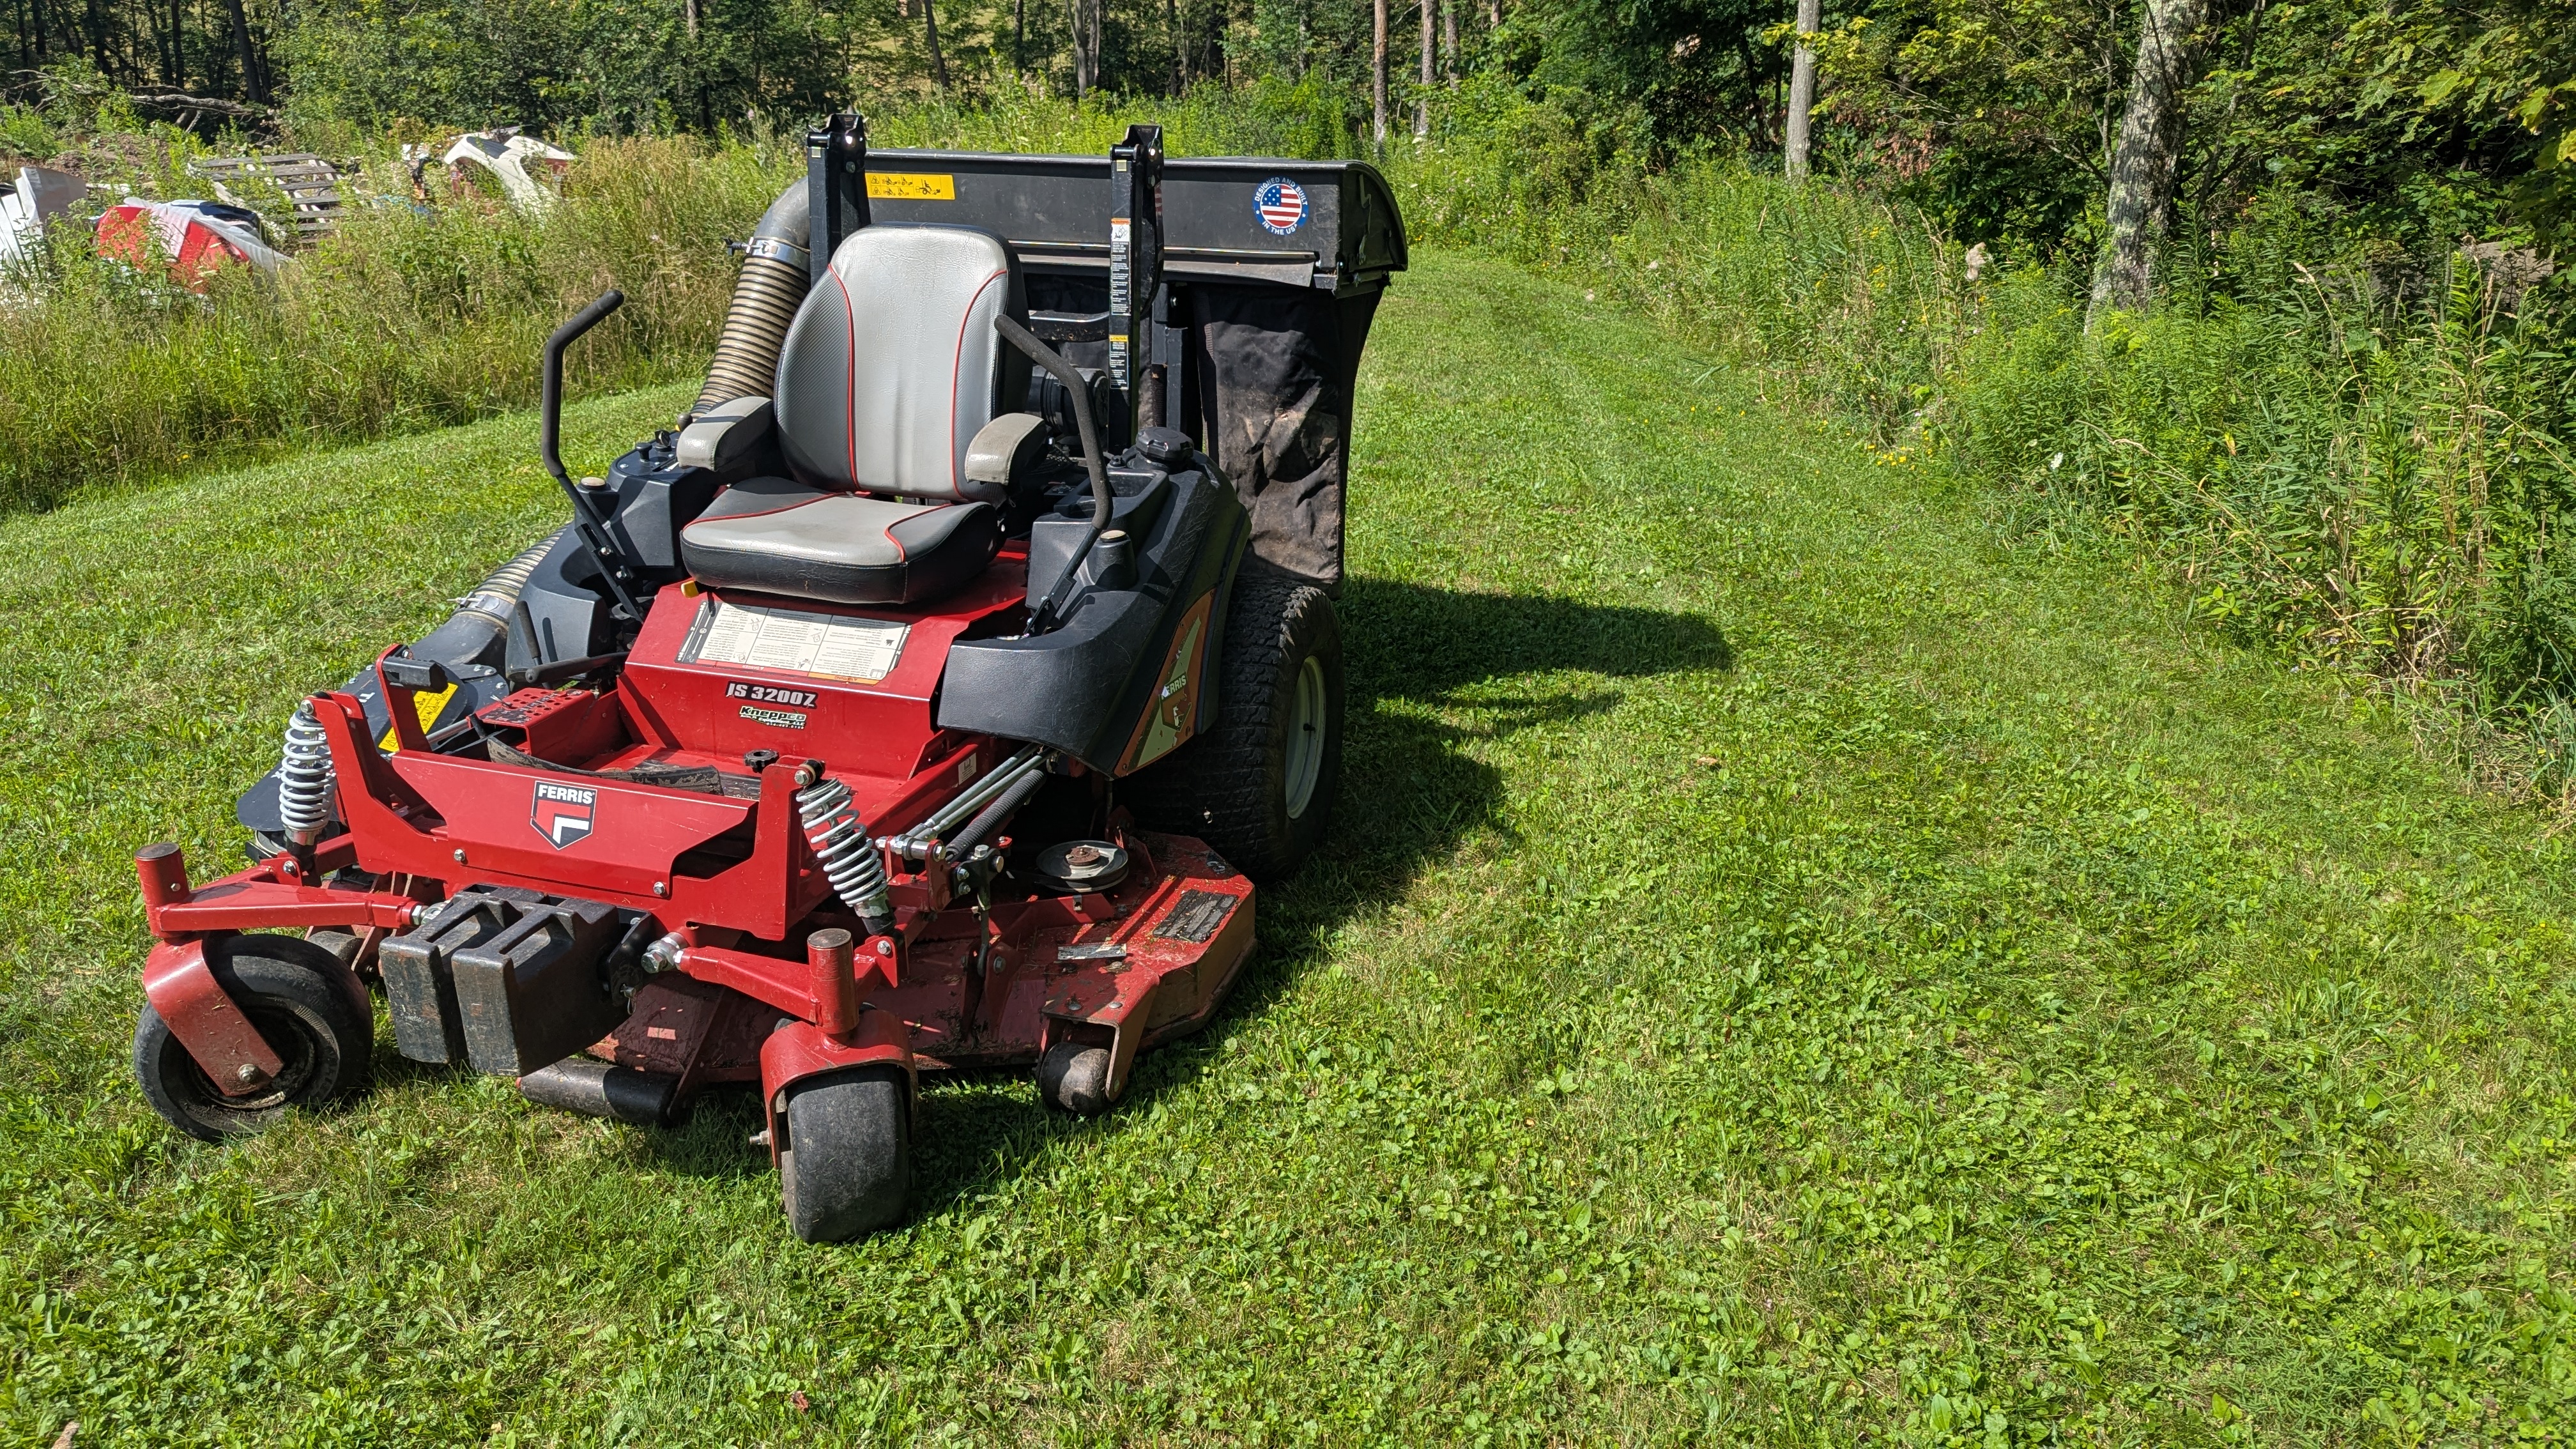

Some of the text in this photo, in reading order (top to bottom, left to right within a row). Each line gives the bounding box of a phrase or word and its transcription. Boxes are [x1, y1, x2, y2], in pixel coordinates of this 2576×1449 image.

[1255, 177, 1308, 206] DESIGNED AND BUILT
[1271, 227, 1284, 235] THE
[751, 686, 816, 707] 3200Z
[740, 706, 806, 721] Kneppco
[538, 785, 593, 804] FERRIS
